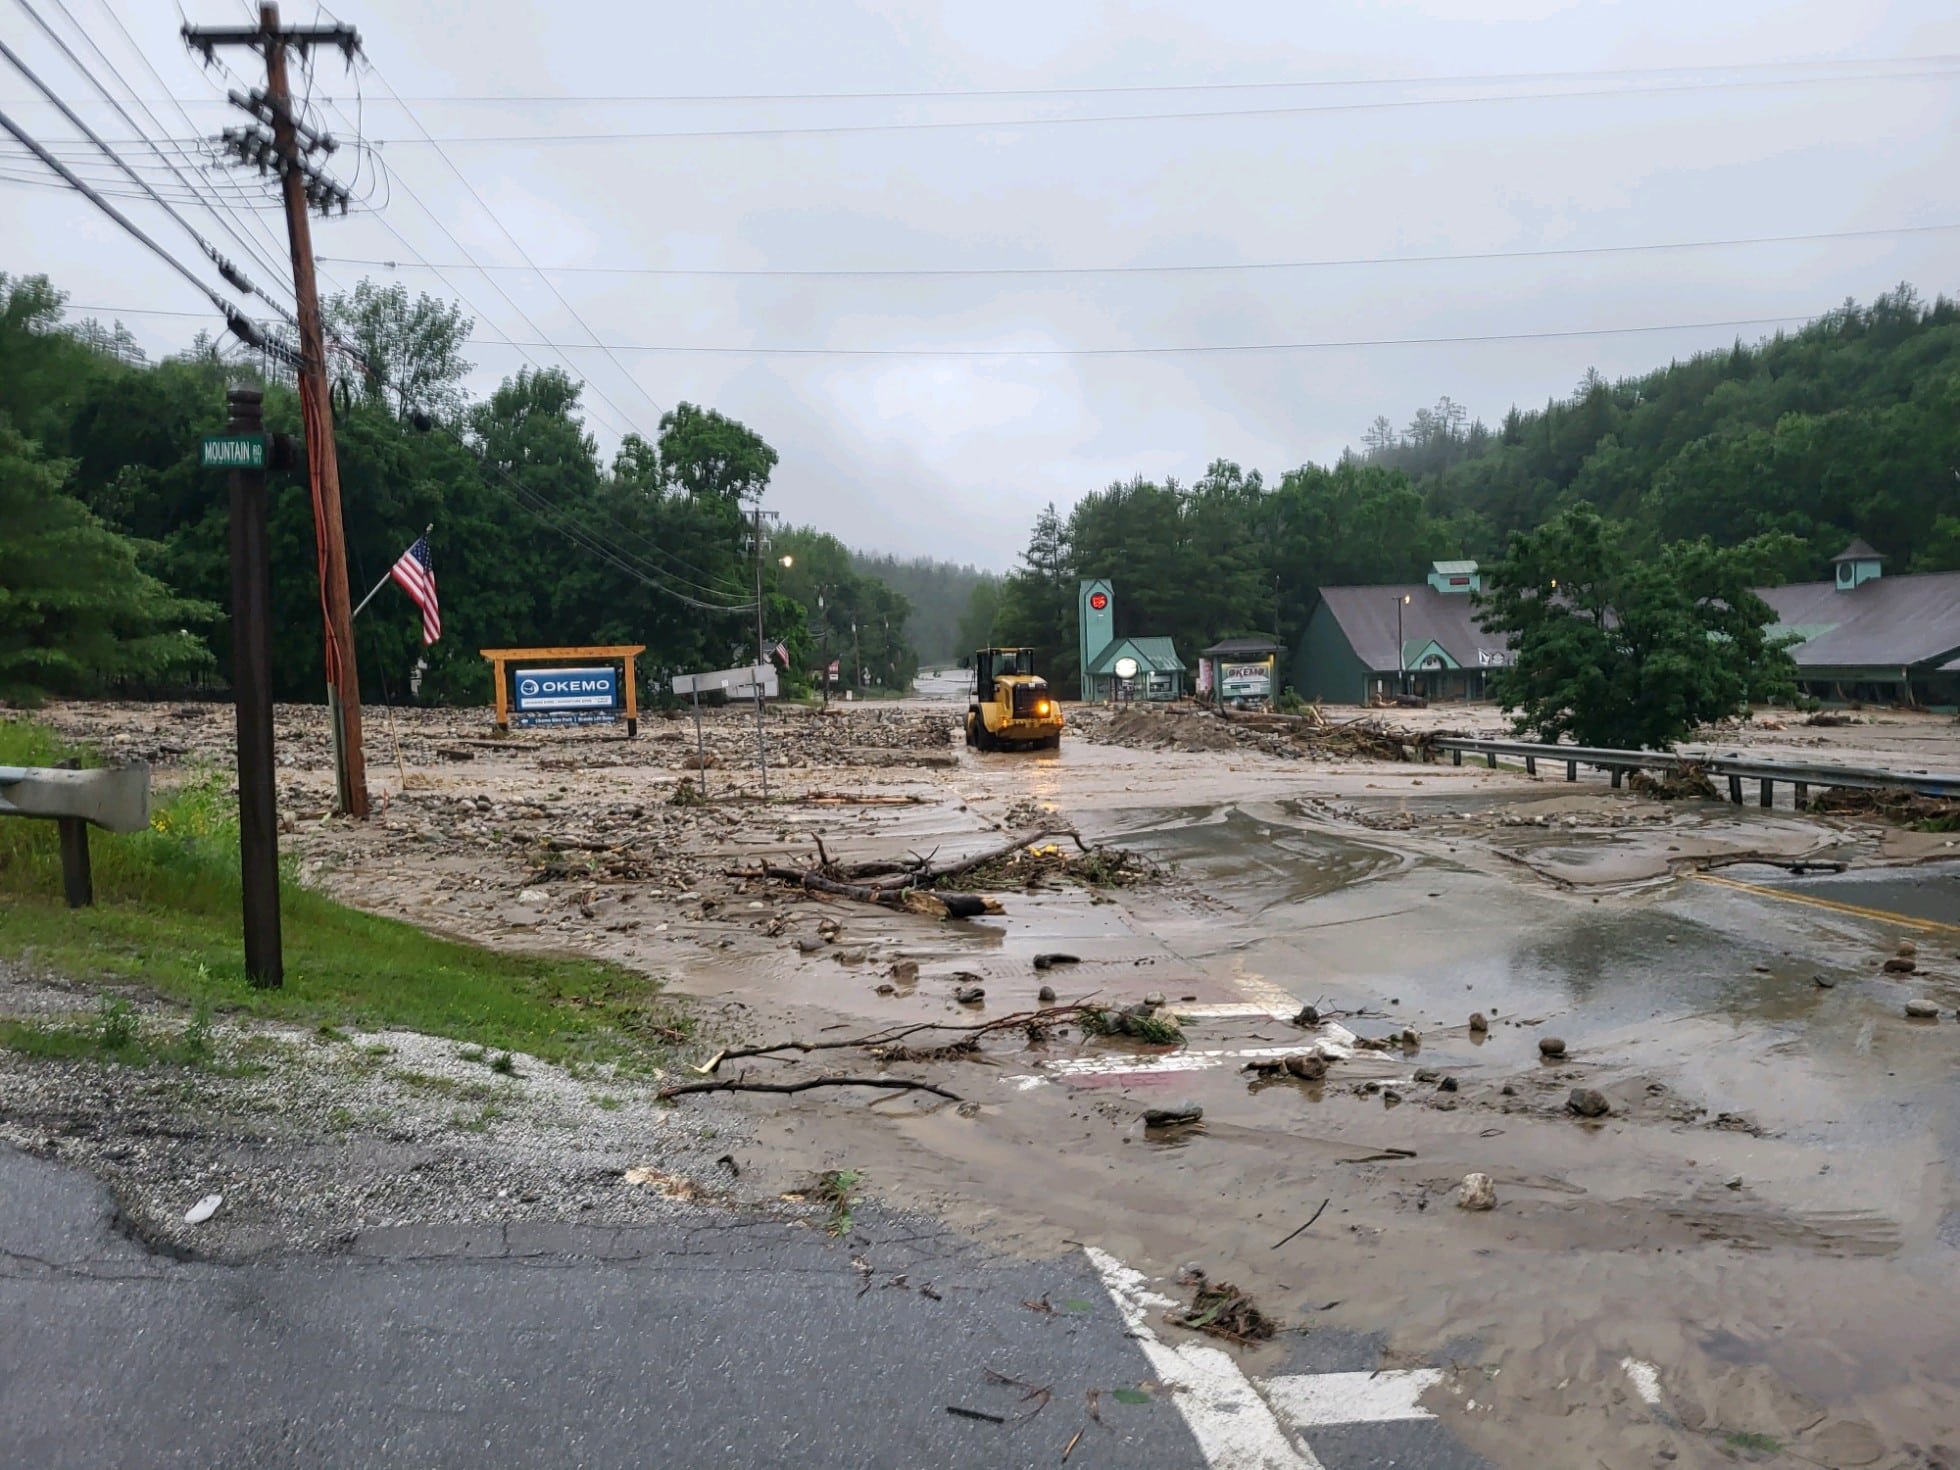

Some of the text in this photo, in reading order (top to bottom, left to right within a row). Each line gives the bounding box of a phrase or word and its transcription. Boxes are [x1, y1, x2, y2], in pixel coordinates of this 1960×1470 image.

[204, 441, 250, 461] MOUNTAIN
[1229, 667, 1265, 678] OKEMO
[543, 680, 609, 691] OKEMO
